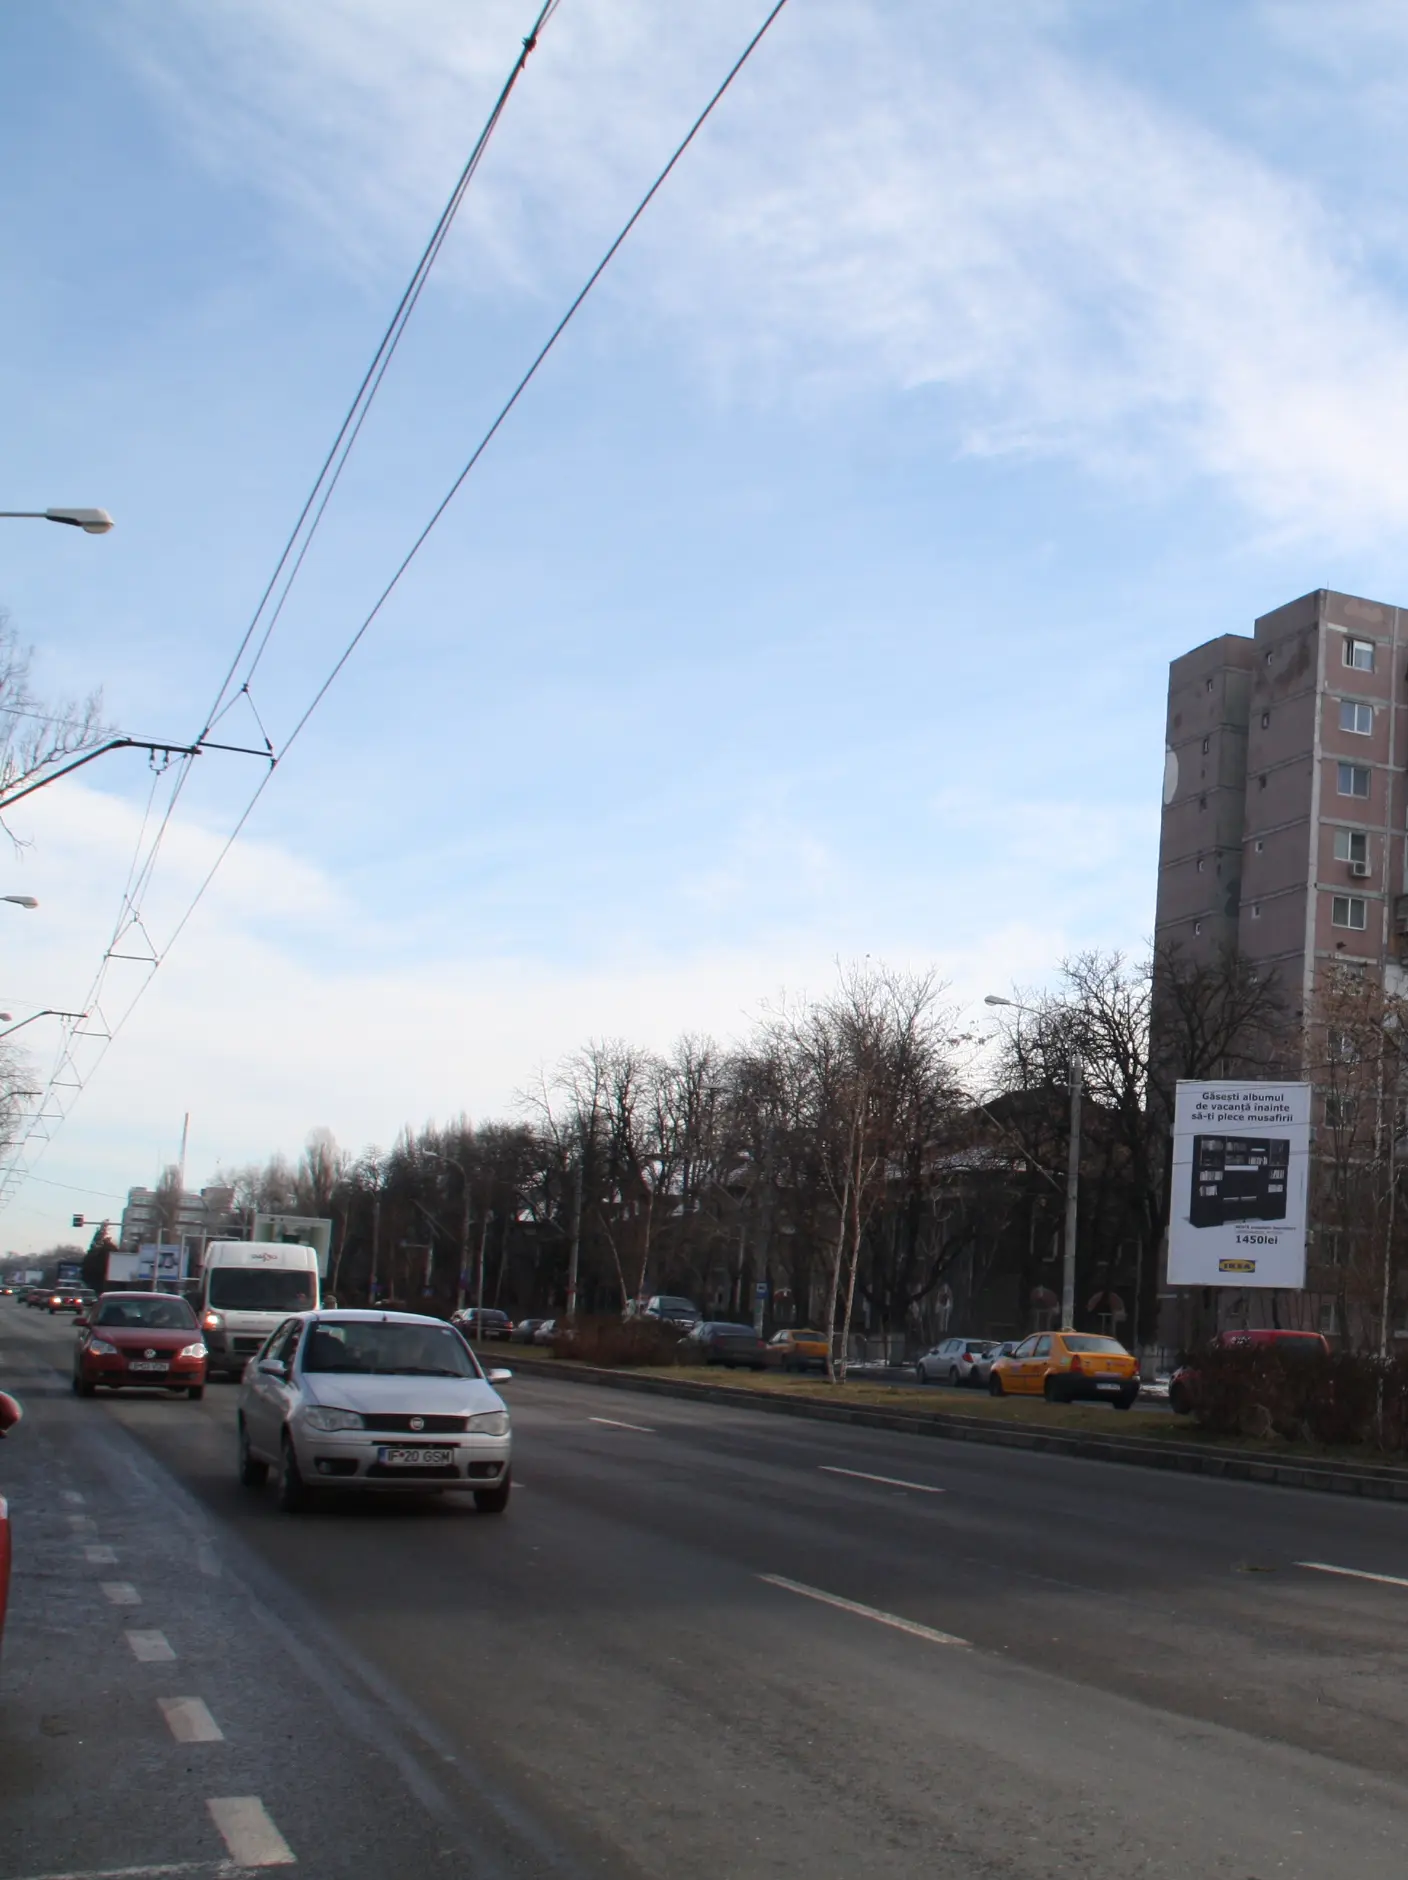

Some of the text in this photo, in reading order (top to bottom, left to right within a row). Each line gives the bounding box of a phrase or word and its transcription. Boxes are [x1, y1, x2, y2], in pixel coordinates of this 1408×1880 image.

[1202, 1091, 1284, 1103] Găsești albumul
[1195, 1102, 1290, 1112] de vacanță înainte
[1217, 1112, 1245, 1122] plece
[1247, 1113, 1293, 1122] musafirii
[1235, 1234, 1278, 1245] 1450lei
[1223, 1262, 1251, 1270] IKEA
[388, 1450, 450, 1463] IF 20 GSM
